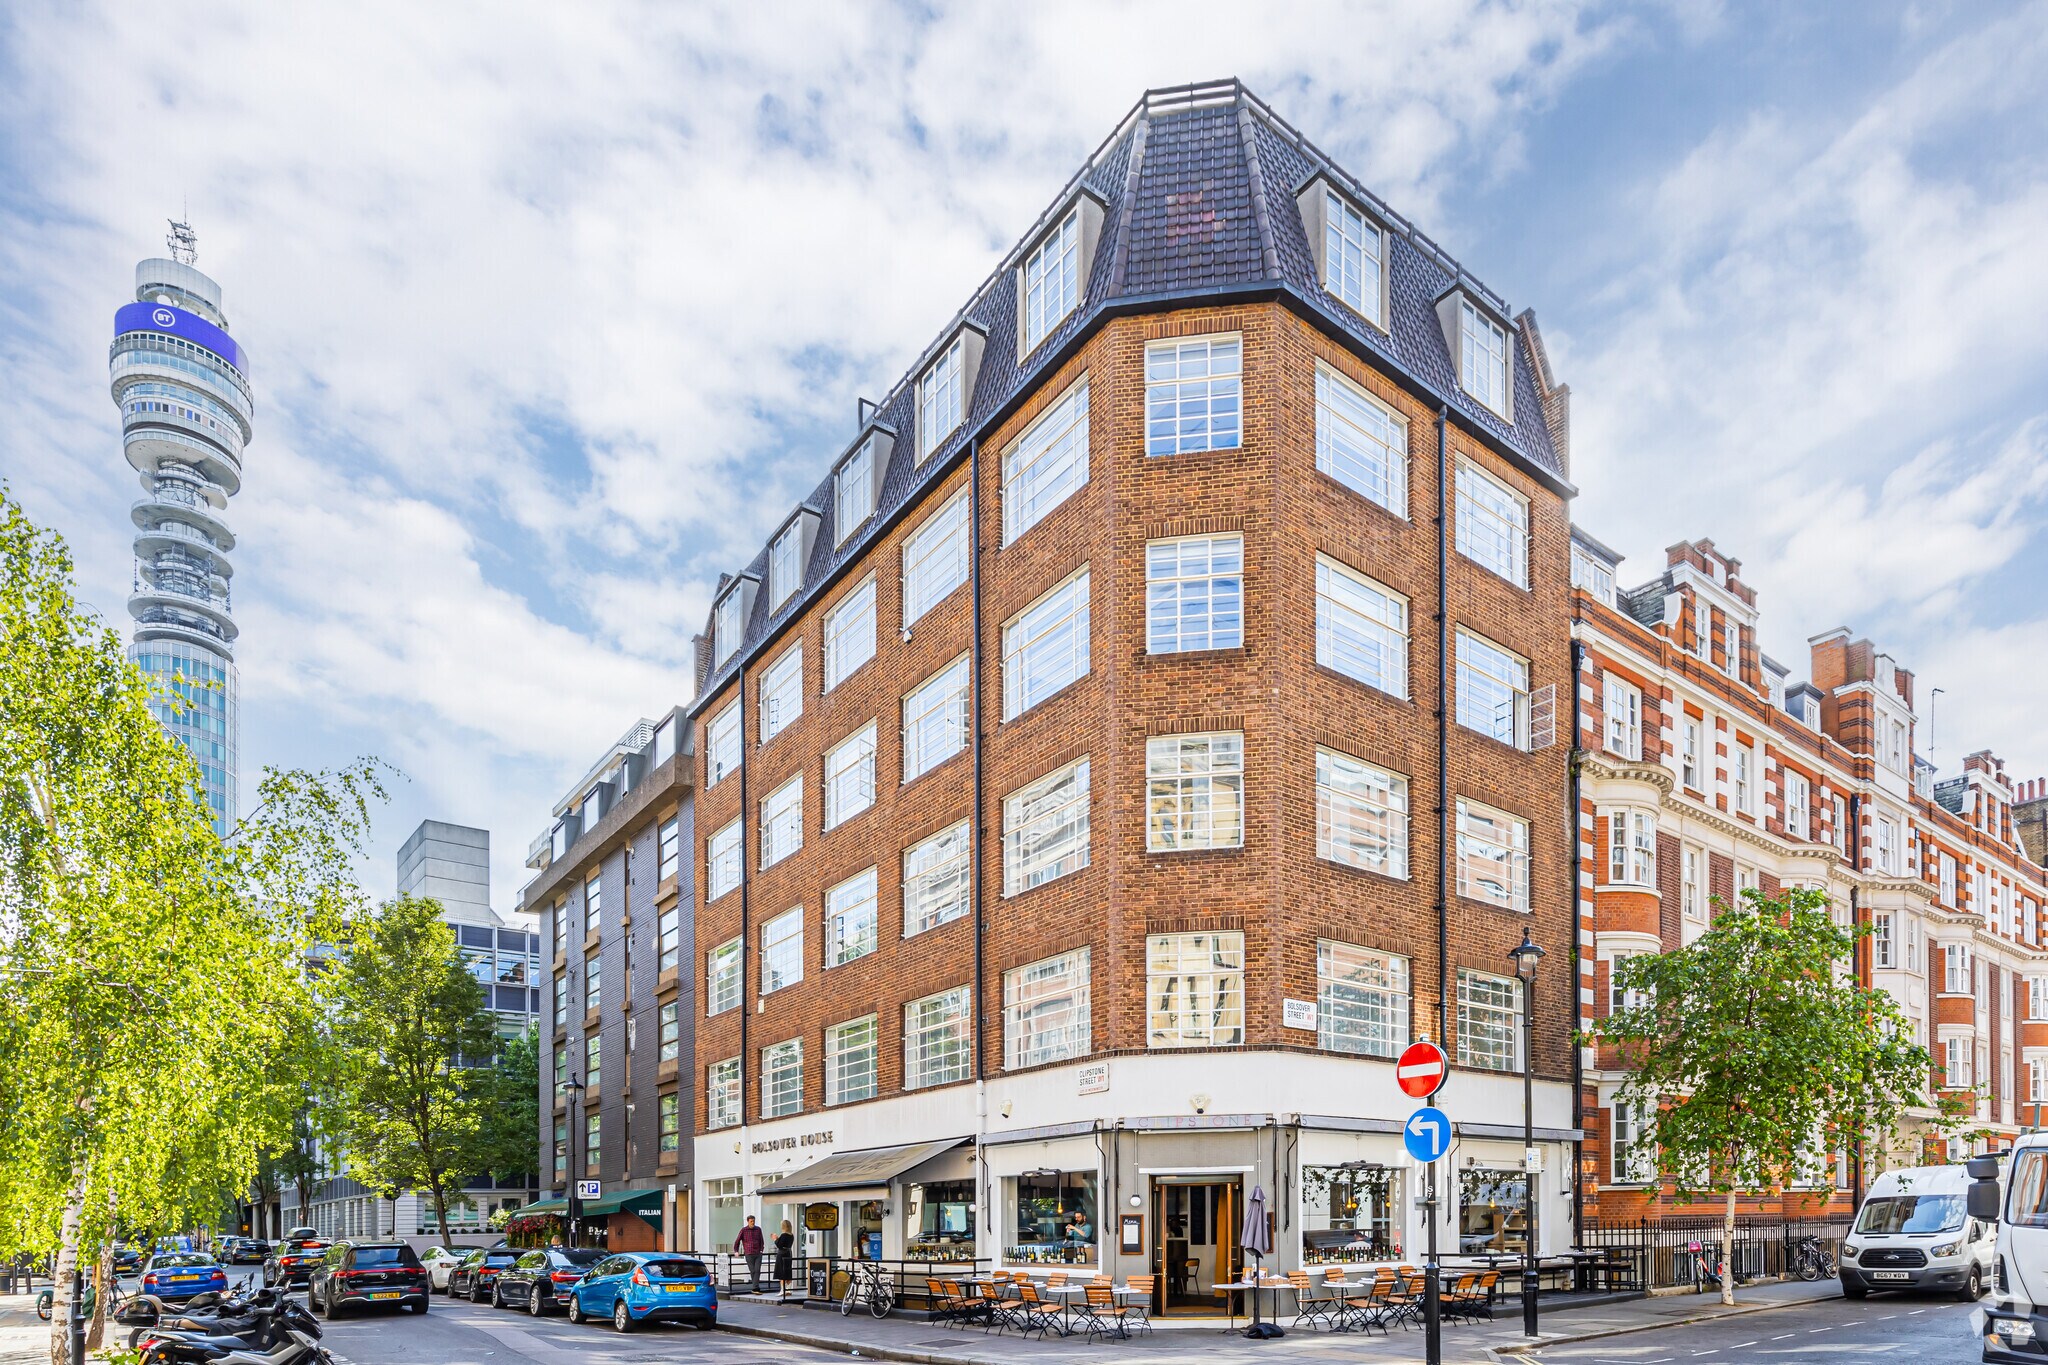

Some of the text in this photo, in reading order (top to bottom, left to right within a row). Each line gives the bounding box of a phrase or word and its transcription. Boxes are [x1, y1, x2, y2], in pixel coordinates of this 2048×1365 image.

[157, 313, 171, 322] BT
[1287, 1001, 1311, 1011] BOLSOVER
[1287, 1010, 1304, 1020] STREET
[1079, 1066, 1105, 1078] CLIPSTONE
[1079, 1076, 1096, 1087] STREET
[1138, 1113, 1252, 1127] CLIPSTONE
[752, 1131, 833, 1153] BOLSOVER HOUSE
[589, 1183, 598, 1193] P
